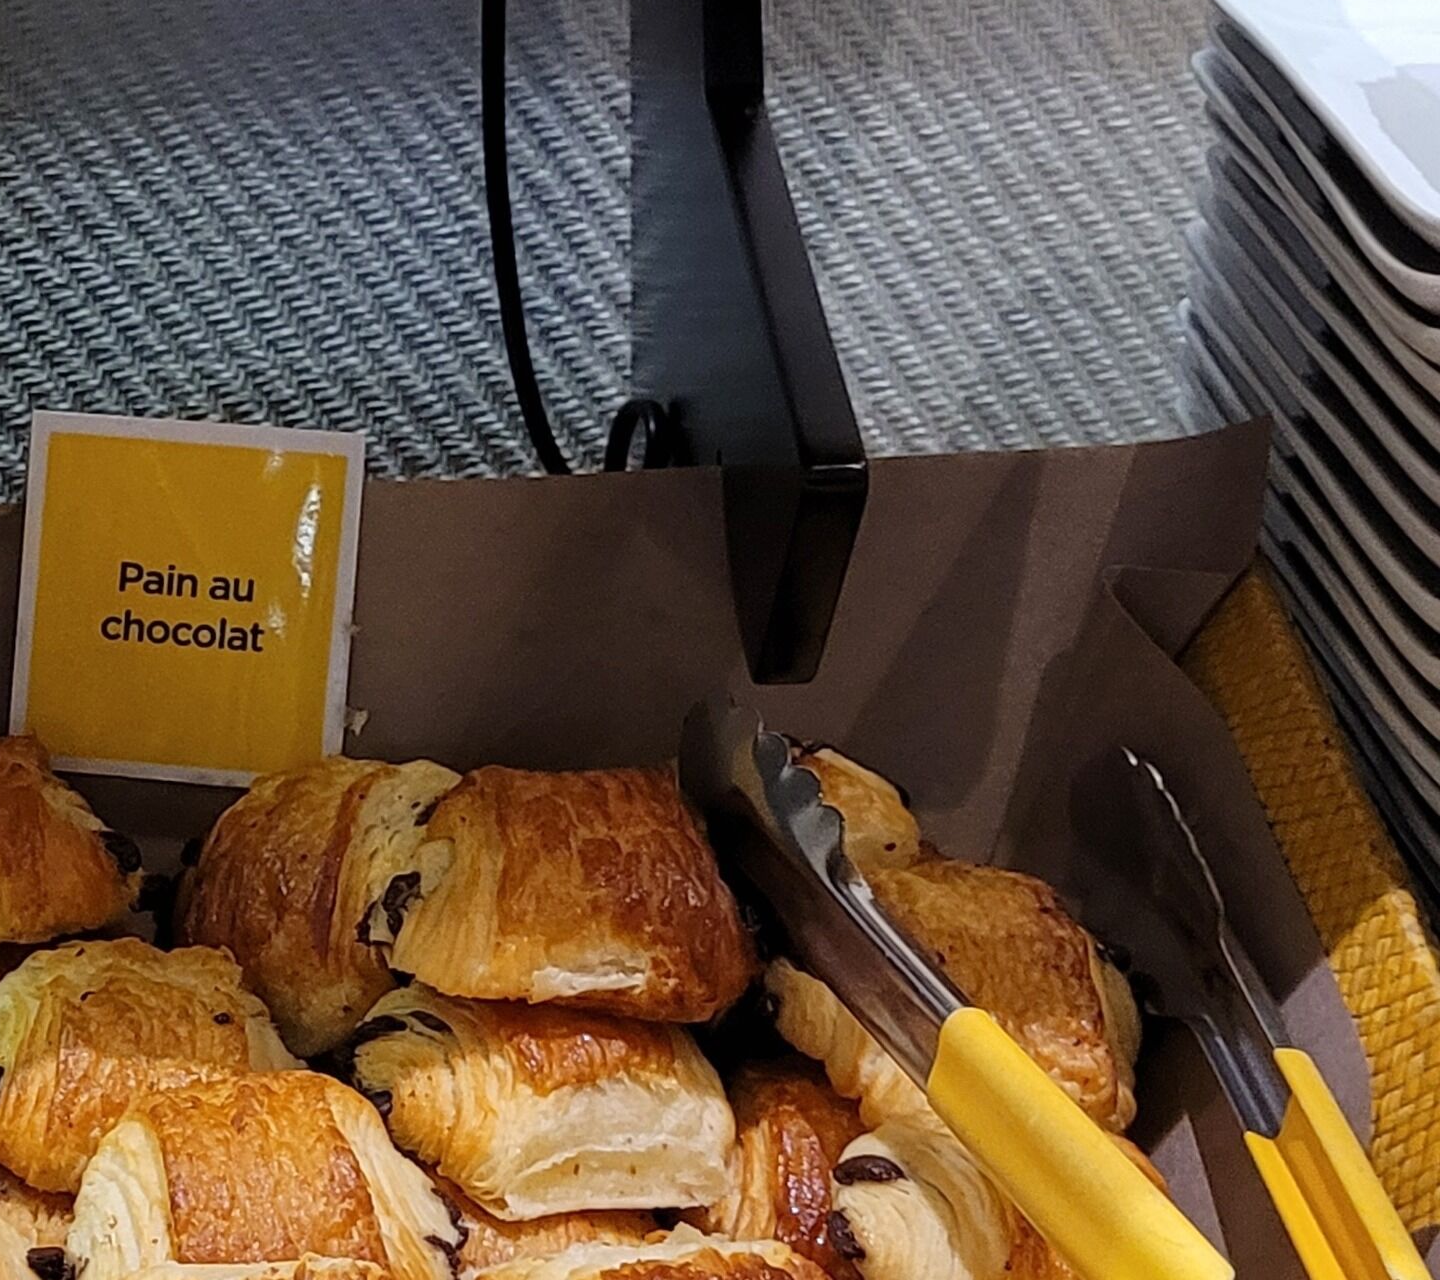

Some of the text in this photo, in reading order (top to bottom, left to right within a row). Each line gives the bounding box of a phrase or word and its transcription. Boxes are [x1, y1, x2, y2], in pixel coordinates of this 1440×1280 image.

[117, 561, 255, 603] Pain au
[100, 609, 265, 653] chocolat
